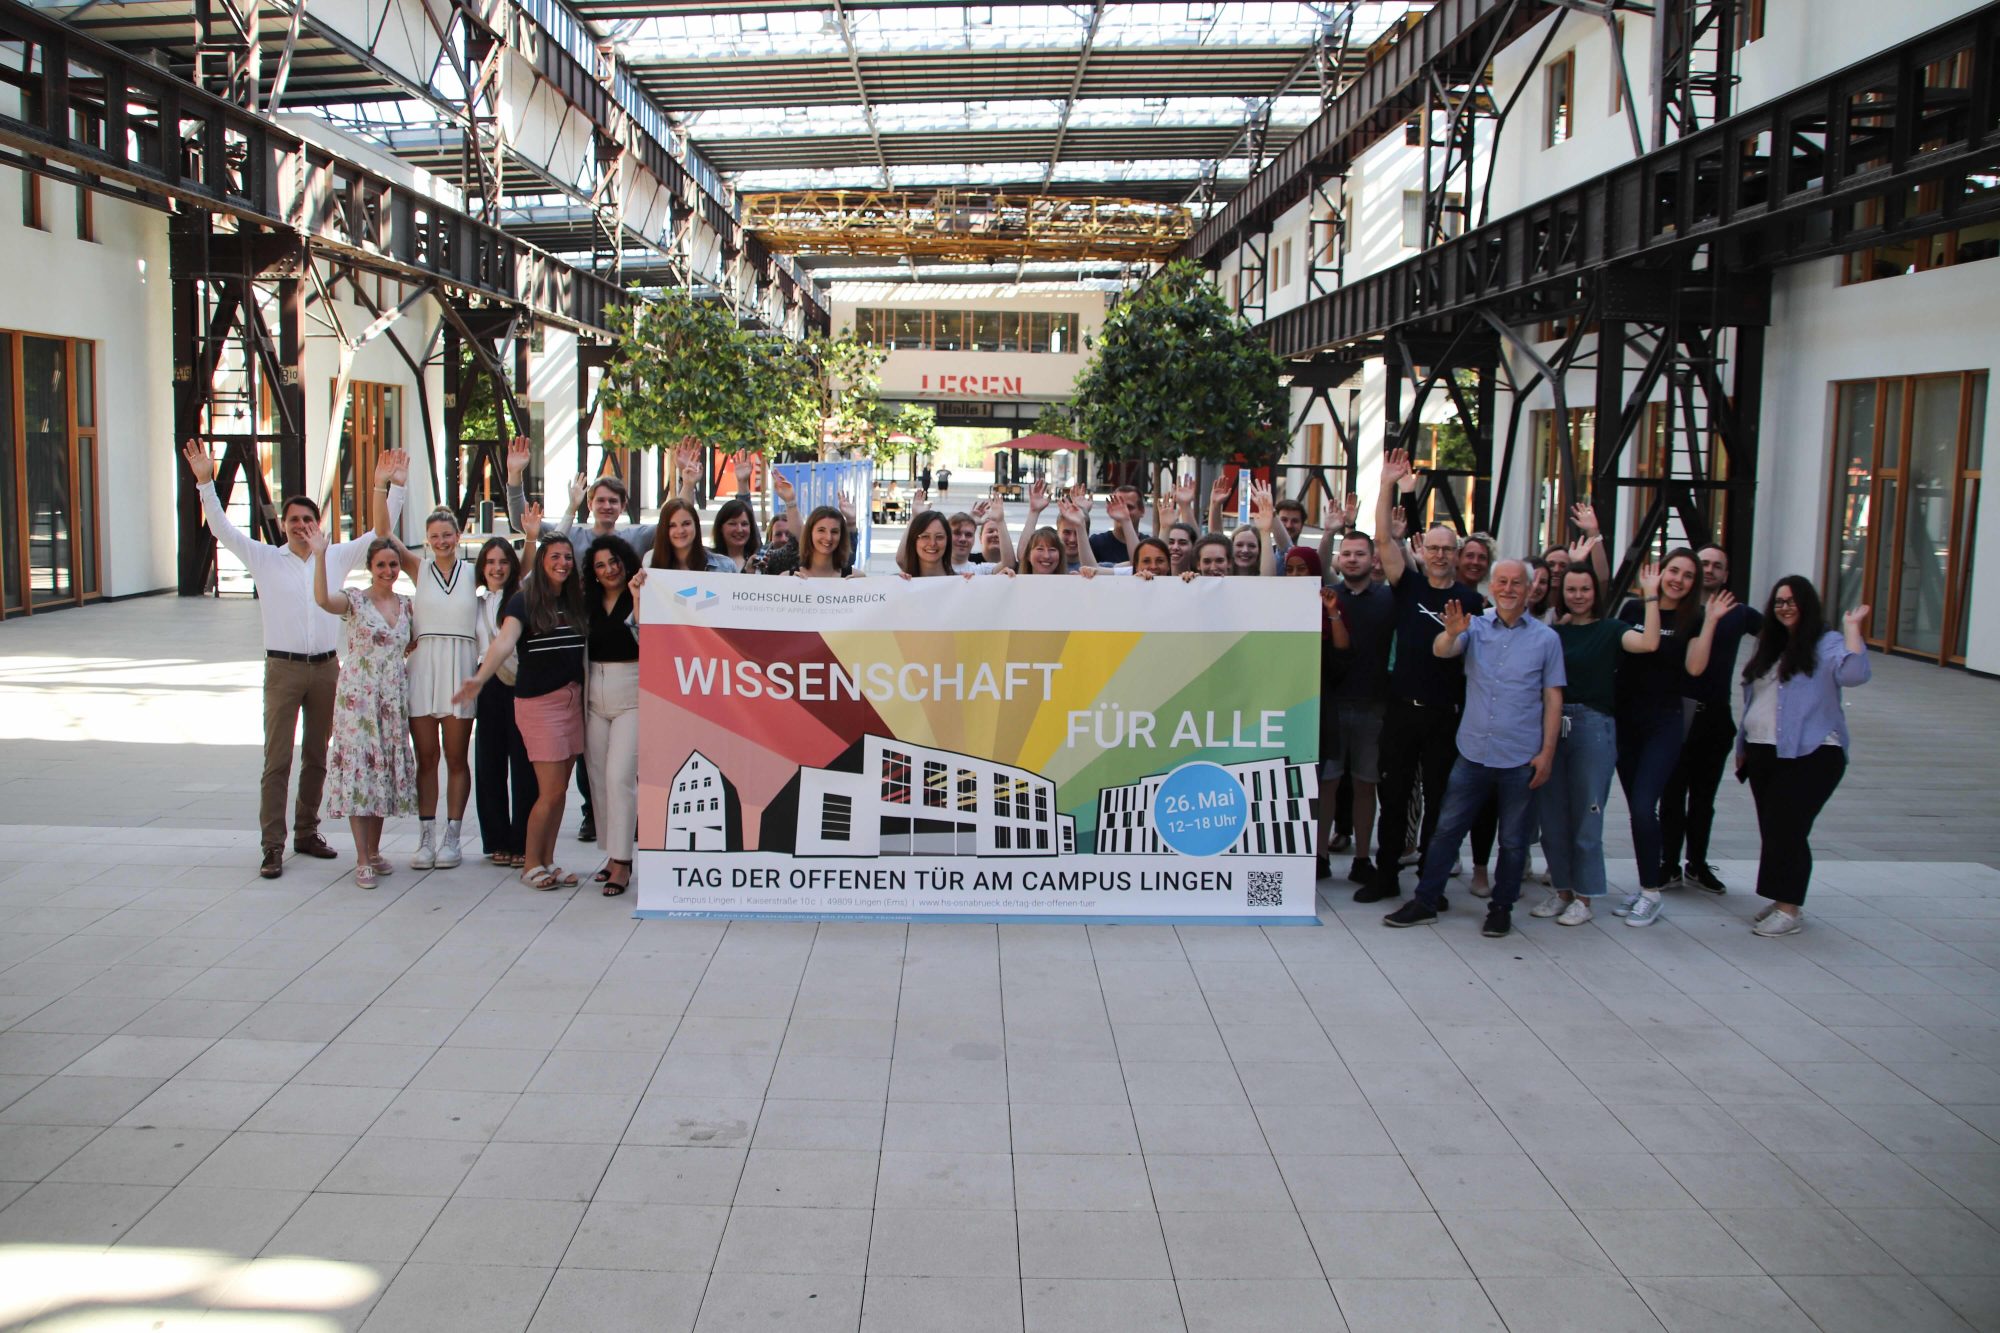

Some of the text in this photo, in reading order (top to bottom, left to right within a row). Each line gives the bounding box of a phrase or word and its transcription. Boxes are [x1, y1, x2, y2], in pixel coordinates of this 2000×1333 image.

[732, 591, 887, 604] HOCHSCHULE OSNABRÜCK
[674, 656, 1063, 701] WISSENSCHAFT
[1067, 702, 1286, 749] FÜR ALLE
[1164, 788, 1235, 814] 26. Mai
[1213, 814, 1237, 828] Uhr
[672, 867, 1233, 892] TAG DER OFFENEN TÜR AM CAMPUS LINGEN
[672, 895, 706, 906] Campus
[708, 895, 736, 906] Lingen
[746, 895, 798, 906] Kaiserstraße
[827, 897, 853, 907] 49809
[854, 897, 882, 908] Lingen
[884, 897, 908, 908] (Ems)
